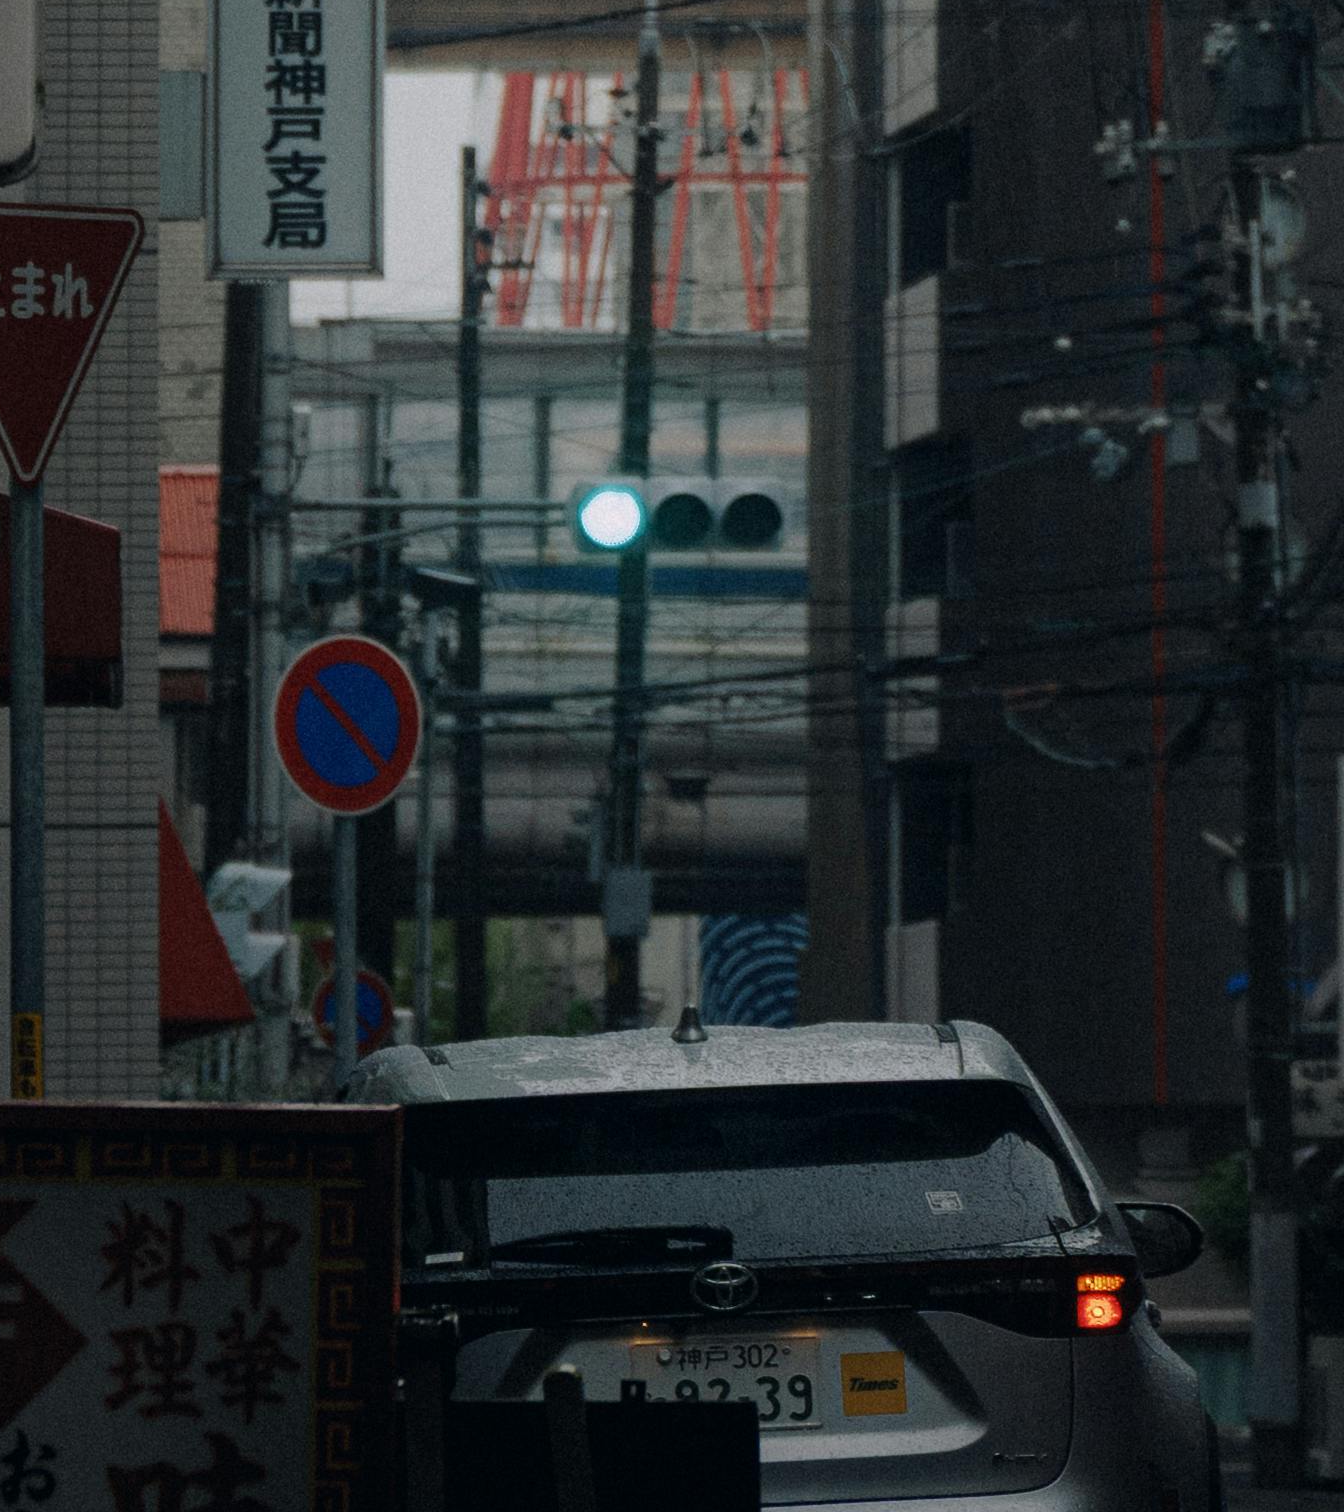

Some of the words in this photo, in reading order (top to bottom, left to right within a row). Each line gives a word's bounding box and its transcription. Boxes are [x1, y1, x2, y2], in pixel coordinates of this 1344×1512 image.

[100, 1199, 202, 1419] 料理
[206, 1193, 302, 1424] 中華
[737, 1344, 779, 1370] 302
[849, 1376, 899, 1394] Times
